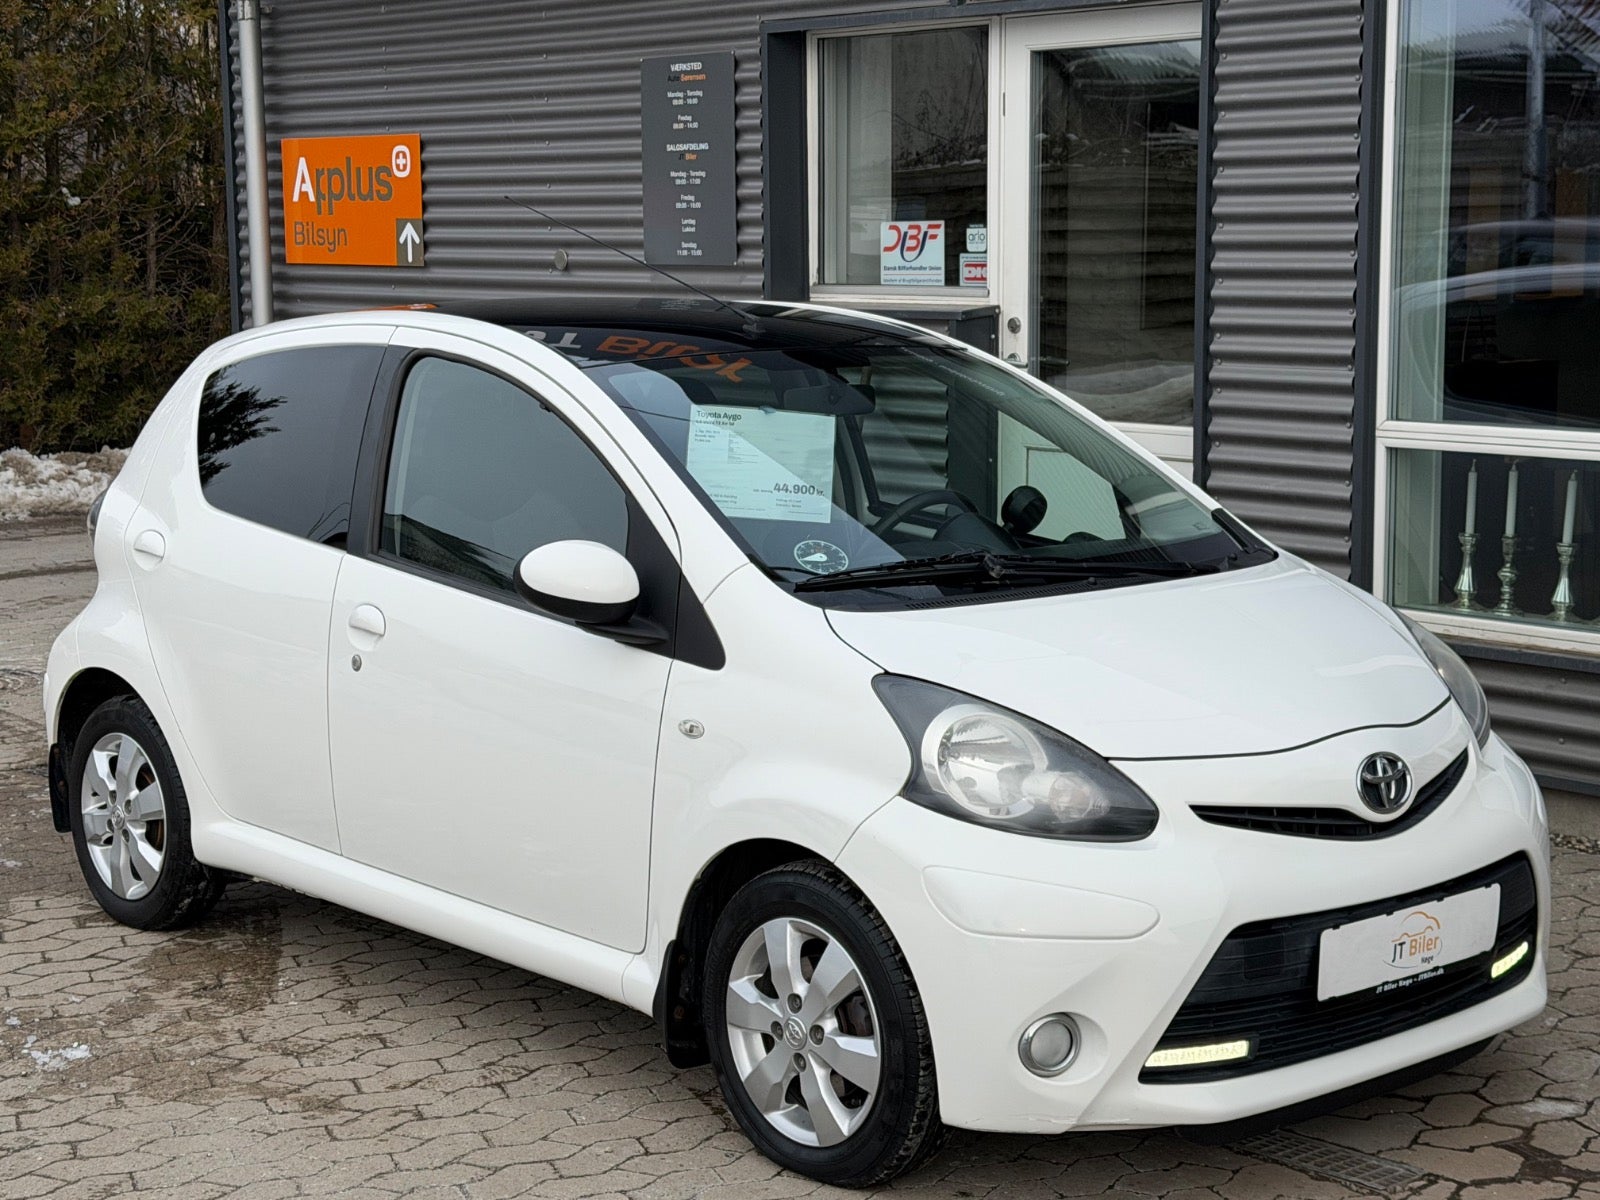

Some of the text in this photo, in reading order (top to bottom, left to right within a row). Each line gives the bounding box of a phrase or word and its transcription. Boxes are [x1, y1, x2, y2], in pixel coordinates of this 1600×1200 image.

[670, 62, 702, 72] VÆRKSTED
[294, 221, 348, 253] Bilsyn
[697, 410, 742, 421] Toyota Aygo
[773, 482, 816, 496] 44.900
[1391, 935, 1440, 963] JT Biler
